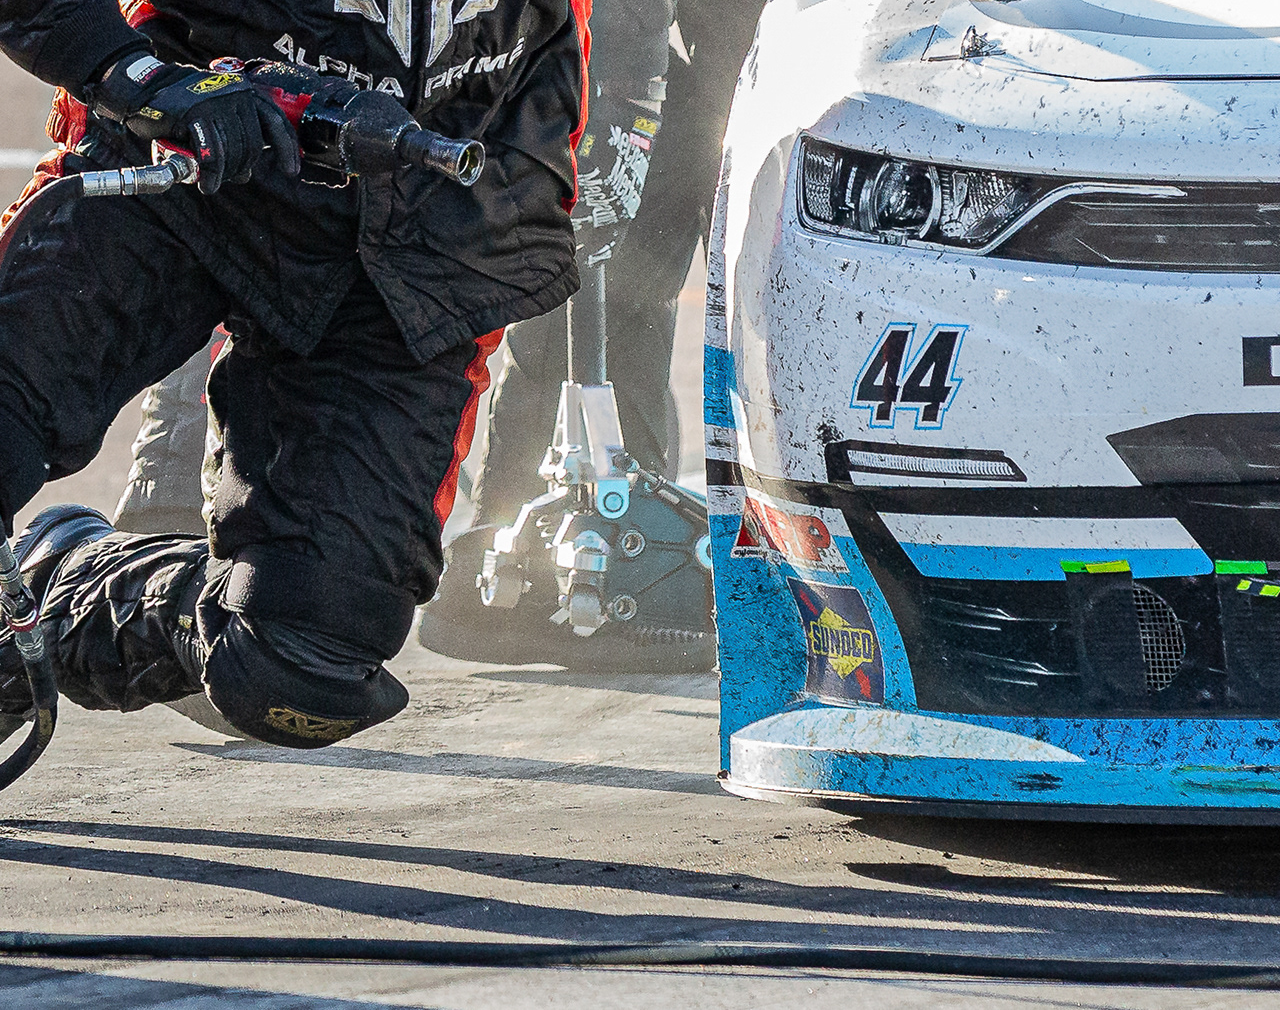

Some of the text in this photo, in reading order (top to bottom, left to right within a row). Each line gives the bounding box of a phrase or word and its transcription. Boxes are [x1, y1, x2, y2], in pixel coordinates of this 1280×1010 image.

[273, 33, 405, 98] ALPHA
[424, 37, 526, 99] PRIME
[850, 323, 970, 430] 44
[811, 622, 874, 660] SUNOCO
